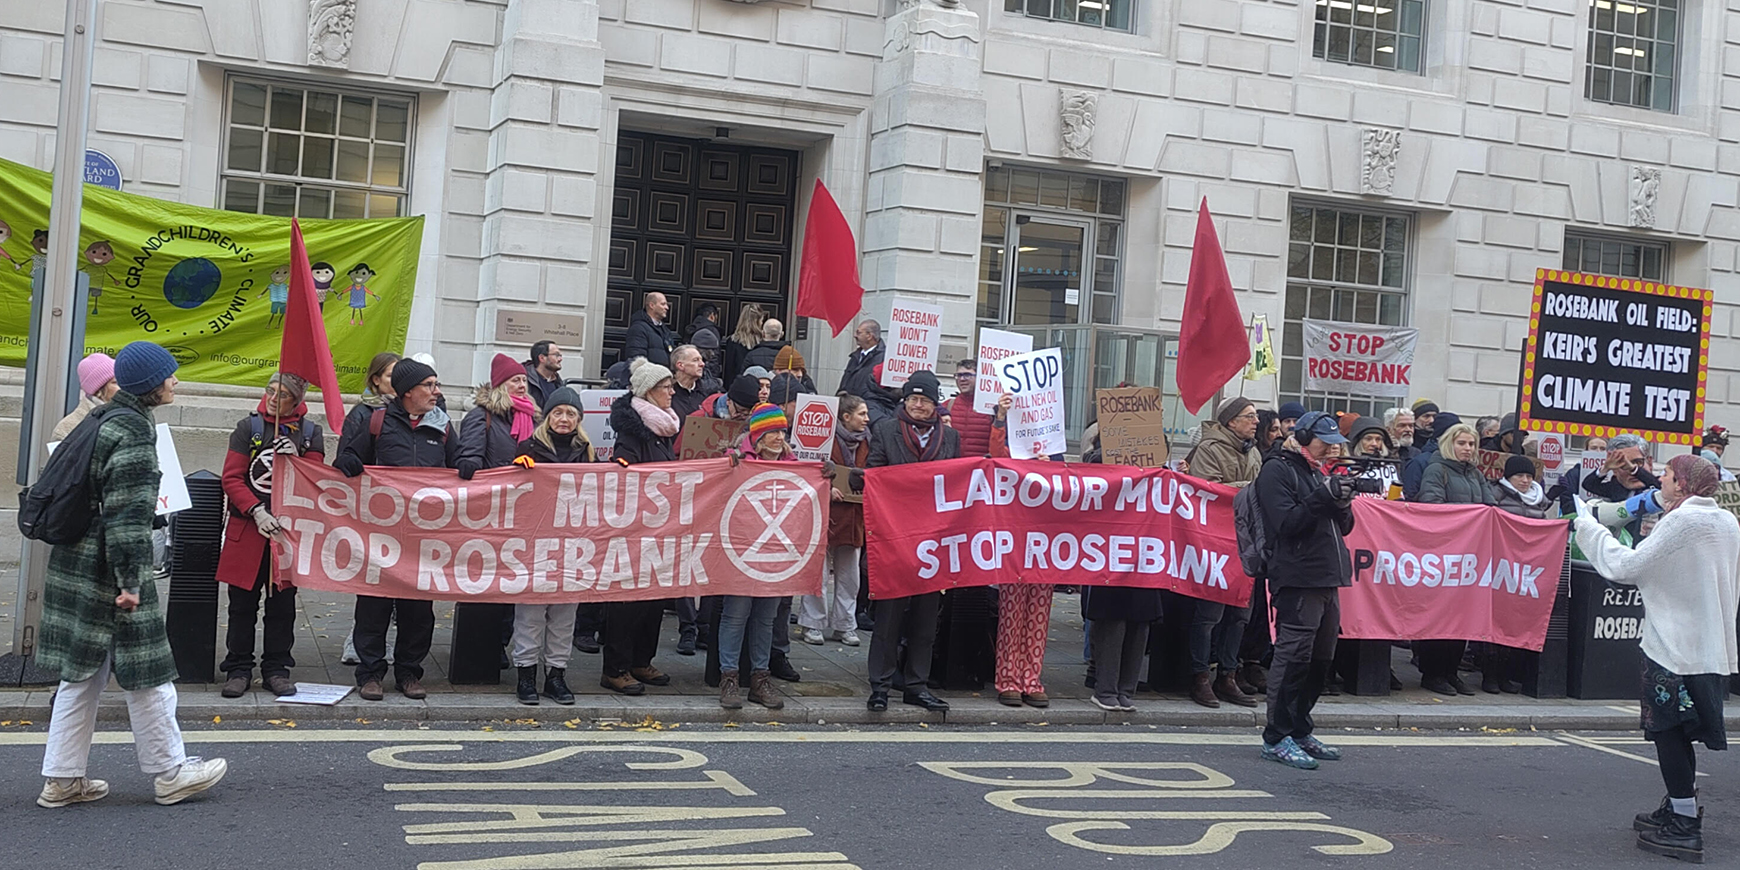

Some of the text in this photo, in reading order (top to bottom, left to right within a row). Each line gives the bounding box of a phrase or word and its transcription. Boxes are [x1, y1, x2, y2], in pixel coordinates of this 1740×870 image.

[125, 225, 253, 289] GRANDCHILDREN'S
[208, 278, 254, 334] CLIMATE
[1545, 292, 1698, 333] ROSEBANK OIL FIELD:
[131, 303, 158, 333] OUR
[892, 308, 940, 328] ROSEBANK
[900, 326, 929, 343] WON'T
[1328, 332, 1385, 356] STOP
[210, 352, 281, 369] info@ourgran
[897, 342, 928, 360] LOWER
[1543, 331, 1692, 374] KEIR'S GREATEST
[887, 358, 906, 374] OUR
[1003, 355, 1059, 393] STOP
[1308, 357, 1412, 385] ROSEBANK
[980, 378, 992, 392] US
[1014, 390, 1058, 410] ALL NEW OIL
[1100, 395, 1160, 414] ROSEBANK
[1536, 373, 1691, 421] CLIMATE TEST
[1020, 406, 1054, 424] AND GAS
[797, 425, 830, 438] ROSEBANK
[1015, 429, 1026, 439] FOR
[595, 446, 608, 457] TOP
[1114, 453, 1155, 468] EARTH
[1478, 450, 1500, 466] TOP
[1582, 457, 1606, 470] ROSE
[282, 458, 704, 532] Labour MUST
[934, 468, 1219, 526] LABOUR MUST
[1714, 493, 1740, 504] ORD
[276, 516, 713, 595] STOP ROSEBANK
[916, 530, 1230, 591] STOP ROSEBANK
[1602, 588, 1642, 606] REJE
[1593, 616, 1644, 640] ROSEBA
[367, 744, 862, 870] STAN
[916, 761, 1394, 856] BUS
